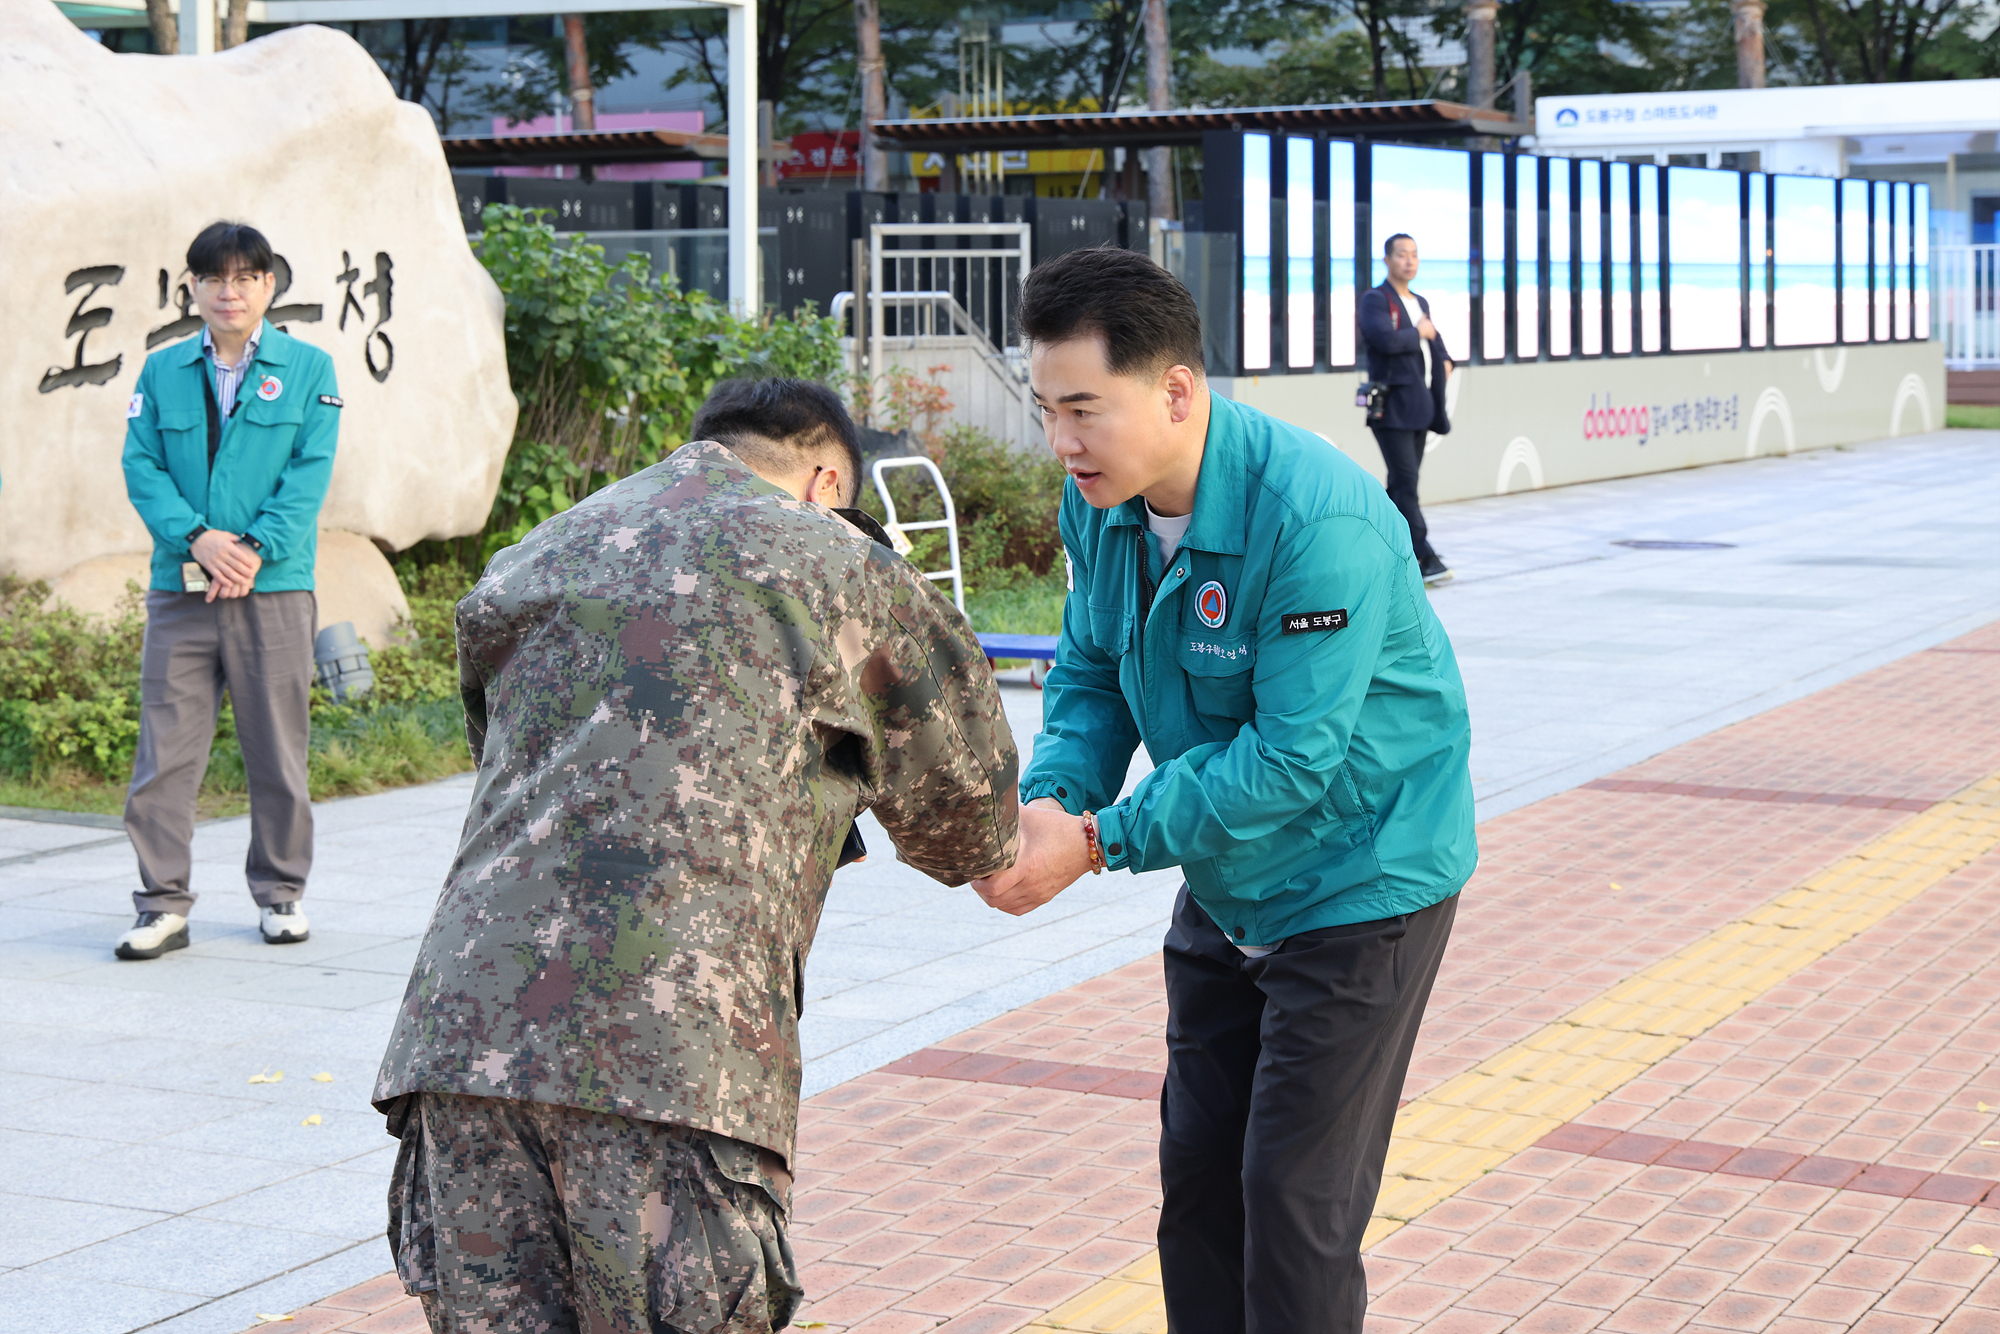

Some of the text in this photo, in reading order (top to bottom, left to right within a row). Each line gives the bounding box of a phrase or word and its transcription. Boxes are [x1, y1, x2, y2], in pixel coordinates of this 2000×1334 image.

[1583, 391, 1649, 446] dobong
[1289, 614, 1342, 630] 서울 도봉구
